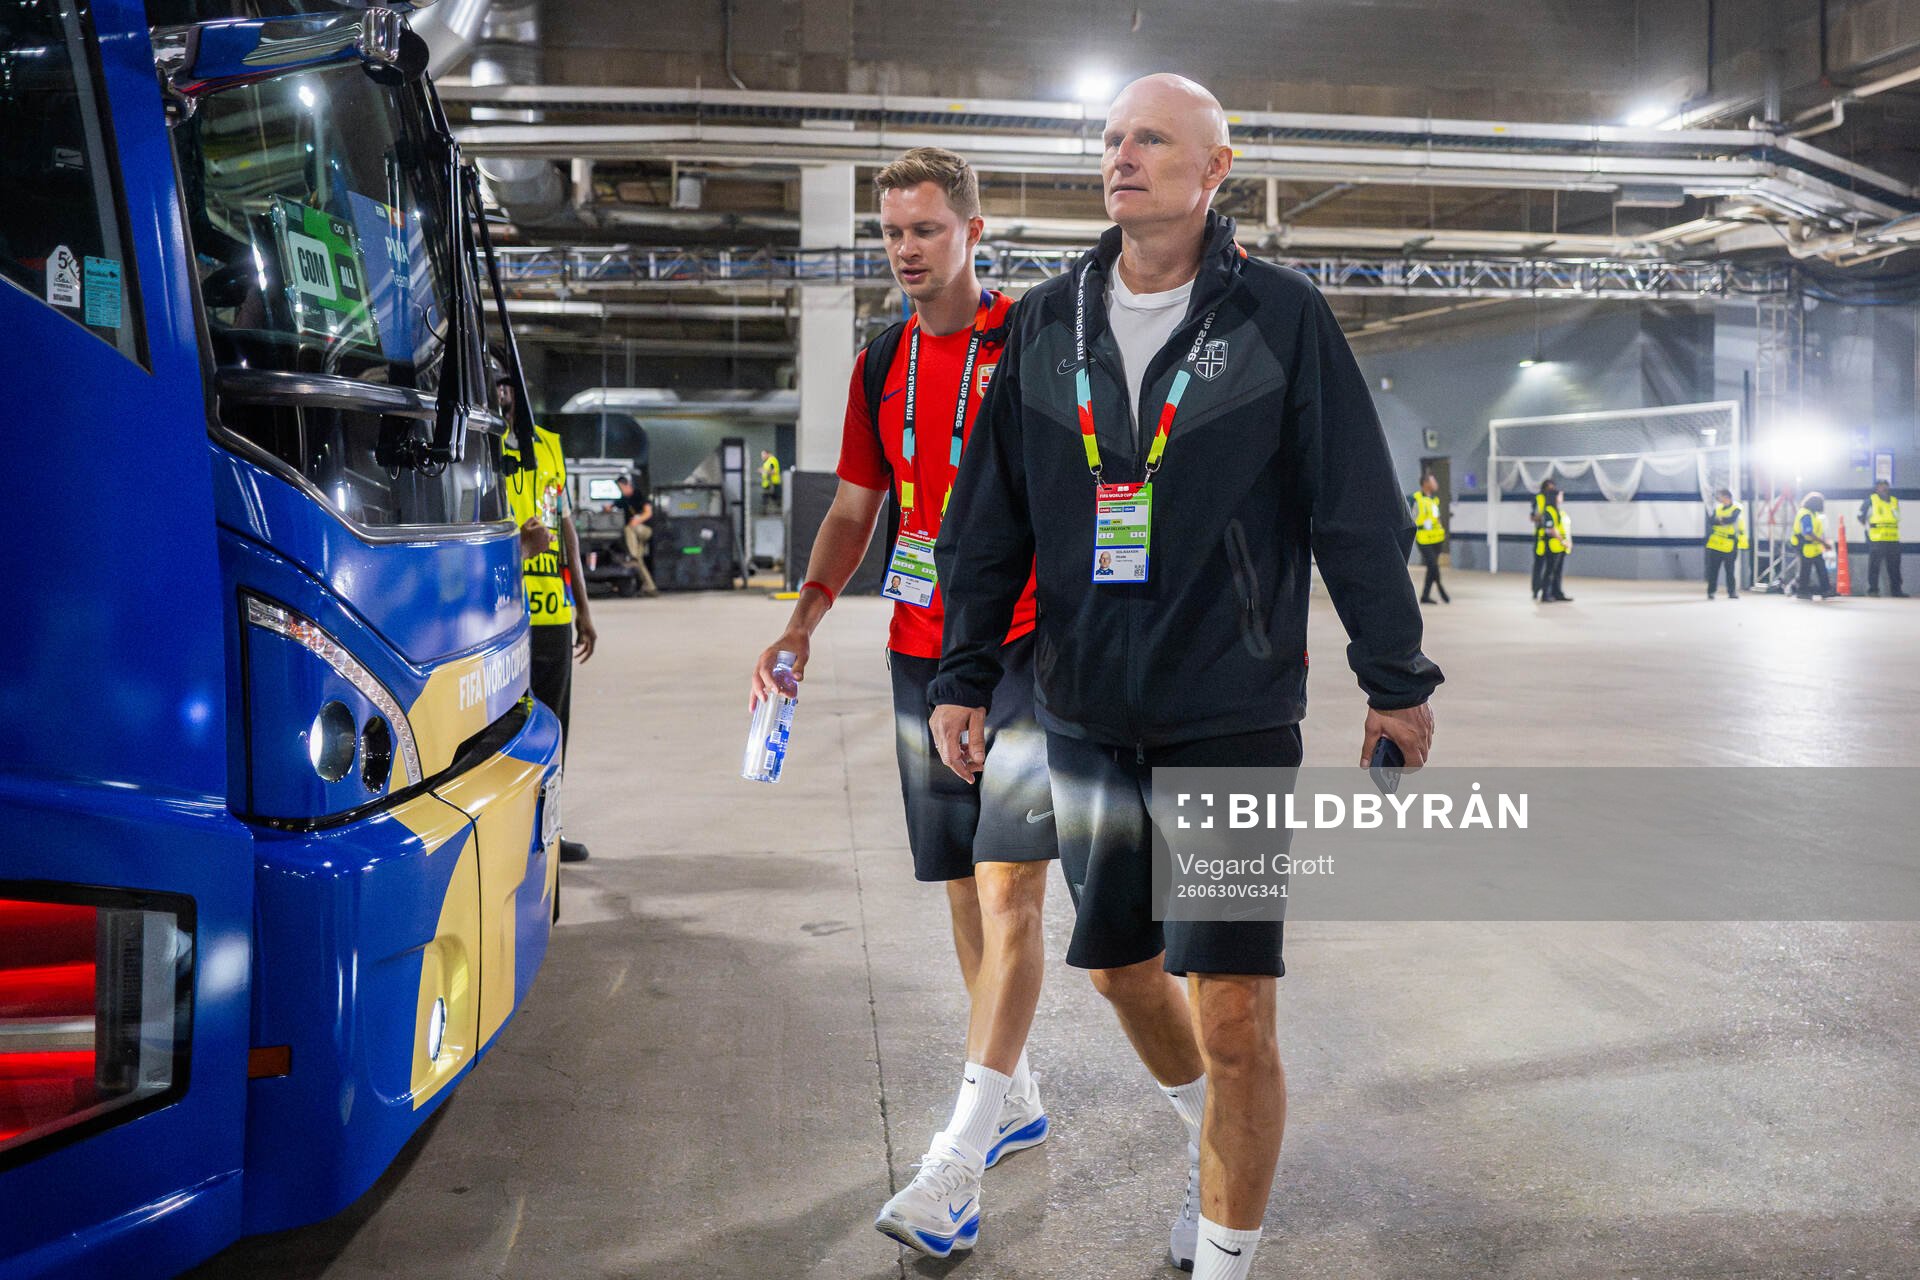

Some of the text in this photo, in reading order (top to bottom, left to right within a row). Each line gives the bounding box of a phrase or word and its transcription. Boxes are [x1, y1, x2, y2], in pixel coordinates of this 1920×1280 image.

[297, 247, 329, 288] COM
[340, 265, 357, 289] ALL
[1076, 288, 1085, 306] CUP
[1076, 305, 1084, 340] WORLD
[1077, 339, 1085, 361] FIFA
[1187, 329, 1207, 362] 2026
[908, 361, 916, 375] CUP
[907, 375, 915, 403] WORLD
[955, 337, 979, 428] FIFA WORLD CUP 2026
[906, 403, 914, 420] FIFA
[524, 552, 558, 574] RITY
[459, 669, 483, 711] FIFA
[483, 655, 511, 697] WORLD
